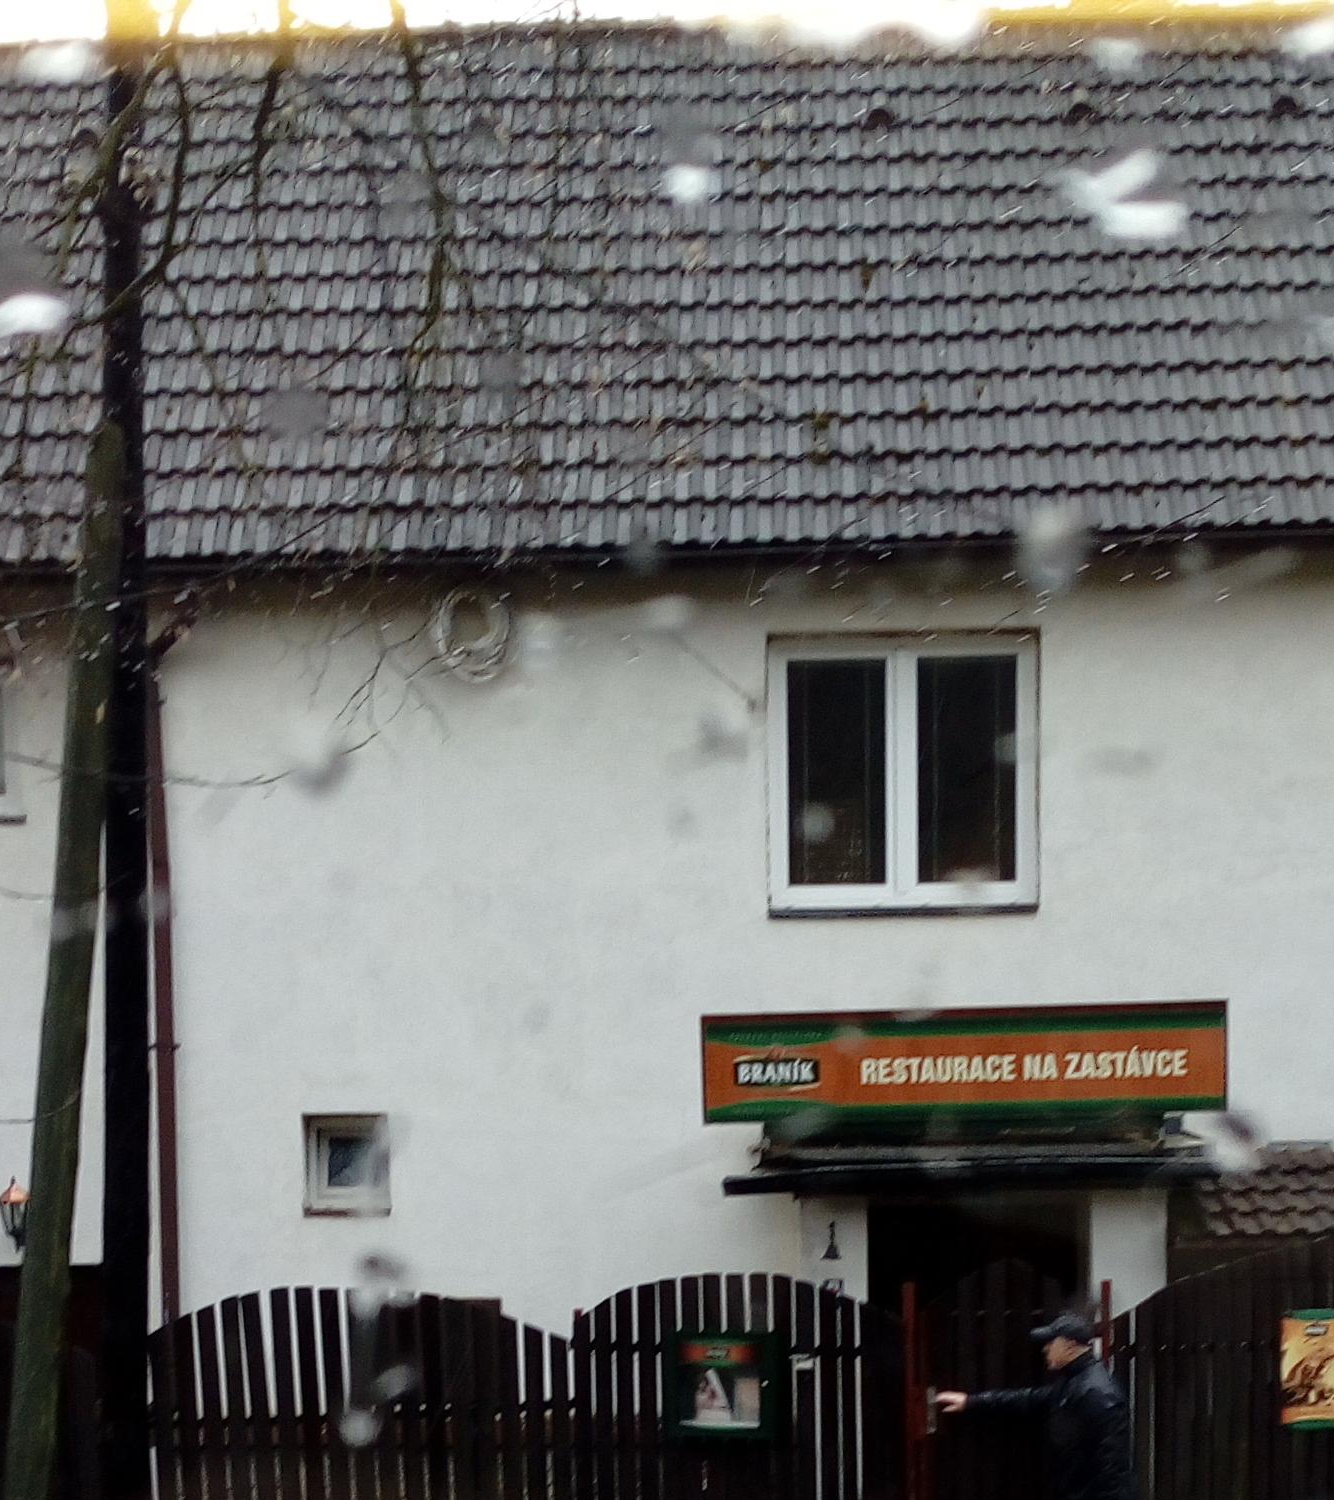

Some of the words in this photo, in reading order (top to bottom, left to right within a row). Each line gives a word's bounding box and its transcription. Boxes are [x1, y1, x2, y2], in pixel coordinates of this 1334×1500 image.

[737, 1057, 816, 1085] BRANÍK
[860, 1054, 1016, 1085] RESTAURACE
[1022, 1053, 1059, 1081] NA
[1063, 1045, 1189, 1080] ZASTÁVCE
